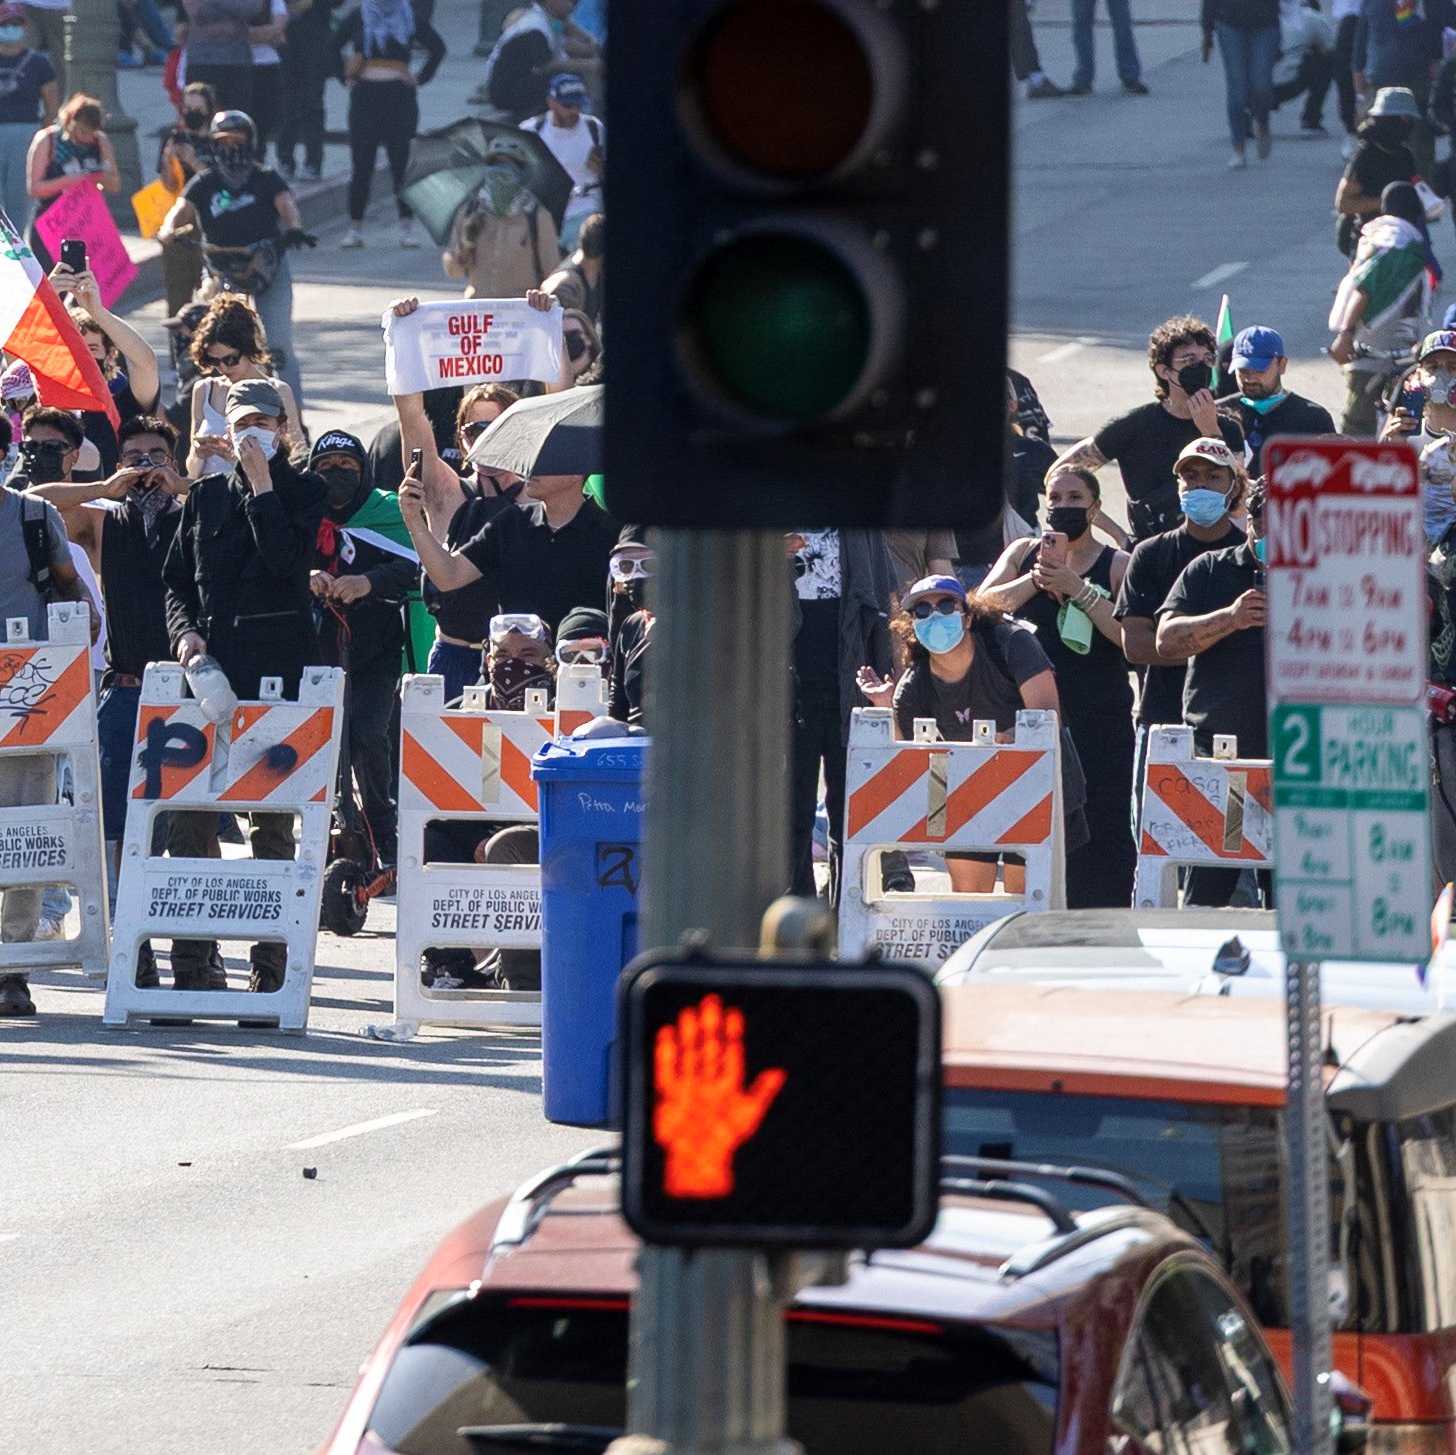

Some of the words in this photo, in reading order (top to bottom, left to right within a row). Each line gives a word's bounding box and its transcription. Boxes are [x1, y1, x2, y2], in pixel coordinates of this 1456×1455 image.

[448, 314, 494, 336] GULF
[460, 335, 482, 356] OF
[439, 354, 503, 379] MEXICO
[317, 434, 356, 451] Kings
[1195, 444, 1231, 458] RAW
[1267, 497, 1315, 563] NO
[1319, 509, 1414, 558] STOPPING
[1283, 712, 1309, 776] 2
[1327, 739, 1417, 787] PARKING
[6, 825, 48, 838] ANGELES
[24, 835, 65, 850] WORKS
[167, 877, 188, 887] CITY
[191, 877, 203, 888] OF
[205, 877, 223, 888] LOS
[226, 878, 268, 890] ANGELES
[151, 887, 181, 900] DEPT.
[185, 888, 199, 900] OF
[202, 889, 240, 902] PUBLIC
[243, 890, 282, 904] WORKS
[149, 900, 205, 917] STREET
[208, 903, 282, 920] SERVICES
[433, 899, 464, 912] DEPT.
[468, 900, 482, 912] OF
[486, 900, 525, 913] PUBLIC
[431, 913, 490, 929] STREET
[494, 914, 542, 931] SERVI
